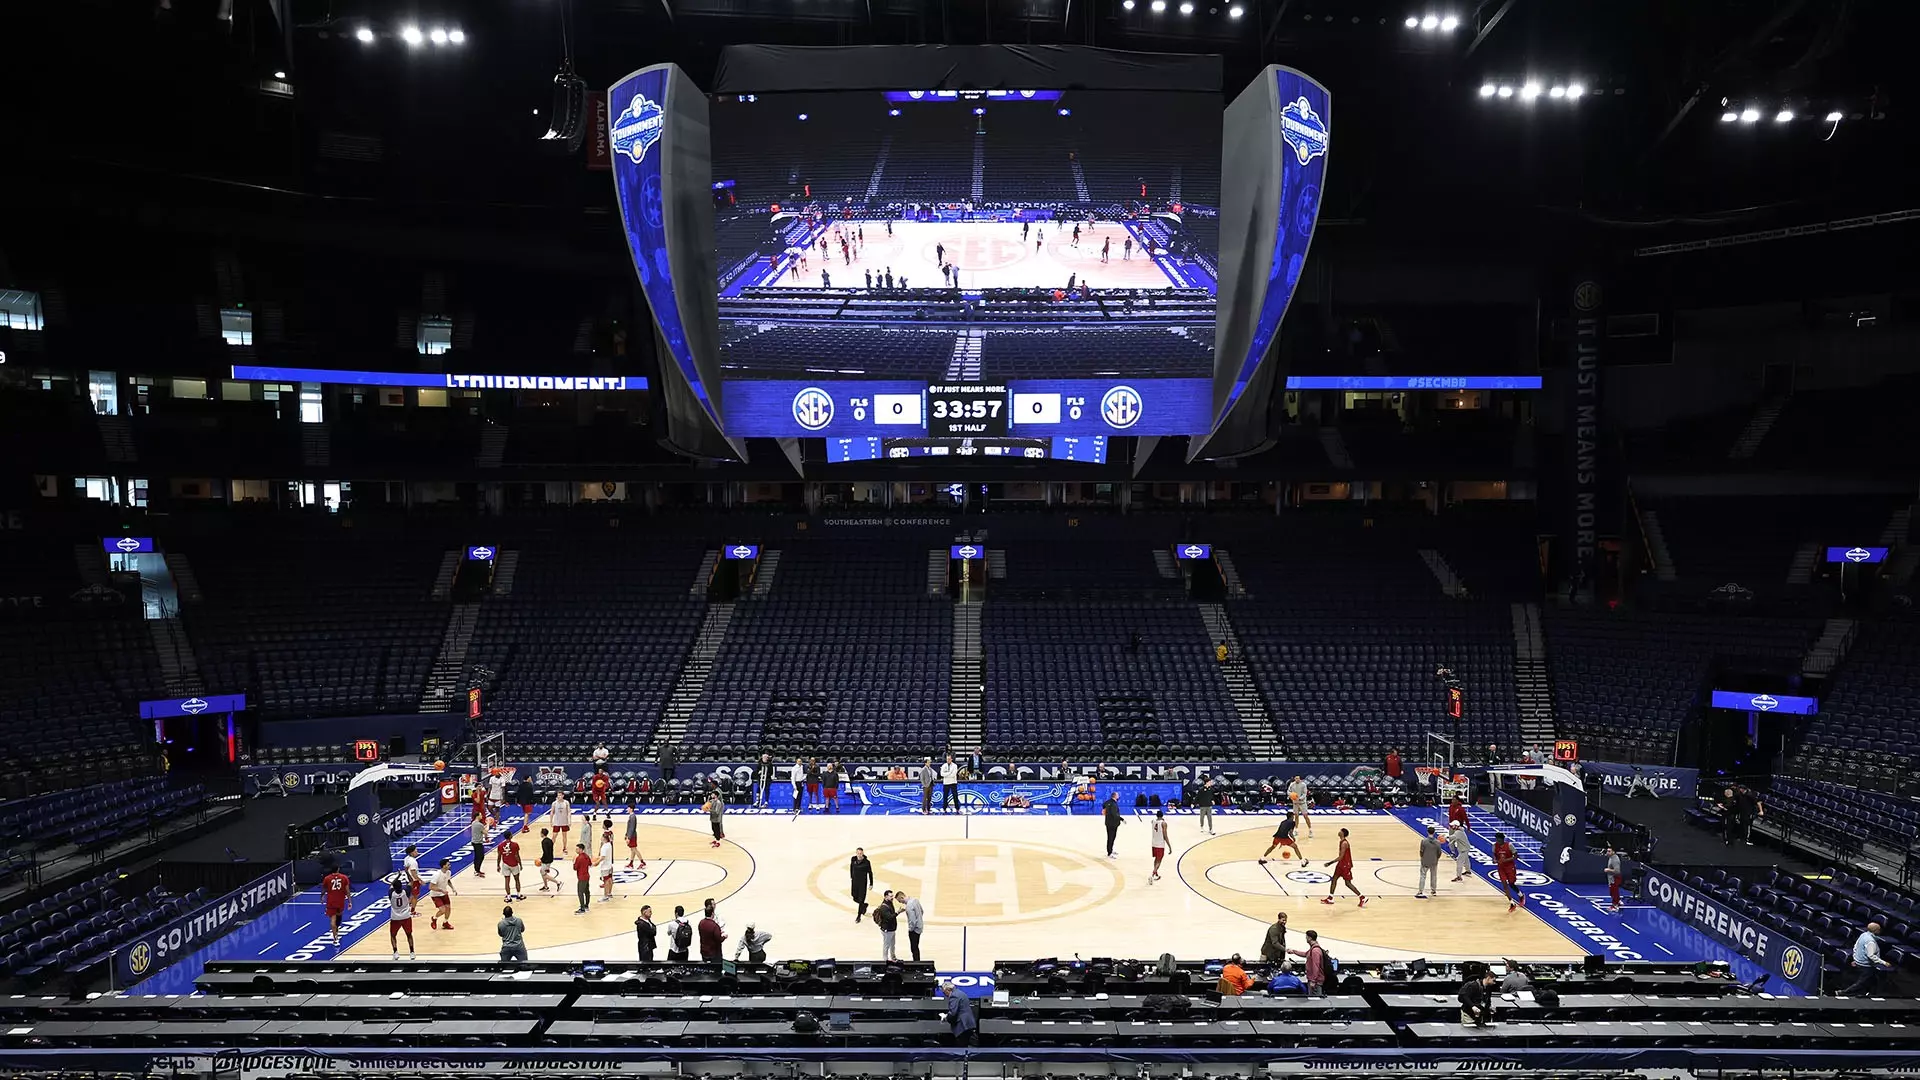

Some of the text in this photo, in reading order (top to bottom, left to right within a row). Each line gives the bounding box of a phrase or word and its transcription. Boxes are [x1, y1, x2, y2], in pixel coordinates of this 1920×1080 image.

[596, 100, 605, 157] ALABAMA
[611, 113, 664, 147] TOURNAMENT
[1281, 115, 1328, 150] TOURNAMENT
[1407, 377, 1467, 389] #SECMBB
[797, 391, 830, 427] SEC
[850, 398, 869, 407] FLS
[853, 407, 866, 421] 0
[892, 403, 903, 414] 0
[933, 400, 1003, 419] 33:57
[1032, 403, 1043, 414] 0
[1066, 397, 1085, 406] FLS
[1069, 406, 1082, 420] 0
[1104, 390, 1138, 426] SEC
[948, 424, 987, 432] 1ST HALF
[1576, 318, 1597, 564] IT JUST MEANS MORE.
[441, 783, 455, 799] G
[1497, 796, 1552, 837] SOUTHEAS
[330, 878, 343, 890] 25
[156, 871, 288, 957] SOUTHEASTERN
[1528, 892, 1644, 961] CONFERENC
[1648, 876, 1769, 957] CONFERENCE
[131, 944, 149, 972] SEC
[1783, 948, 1802, 977] SEC
